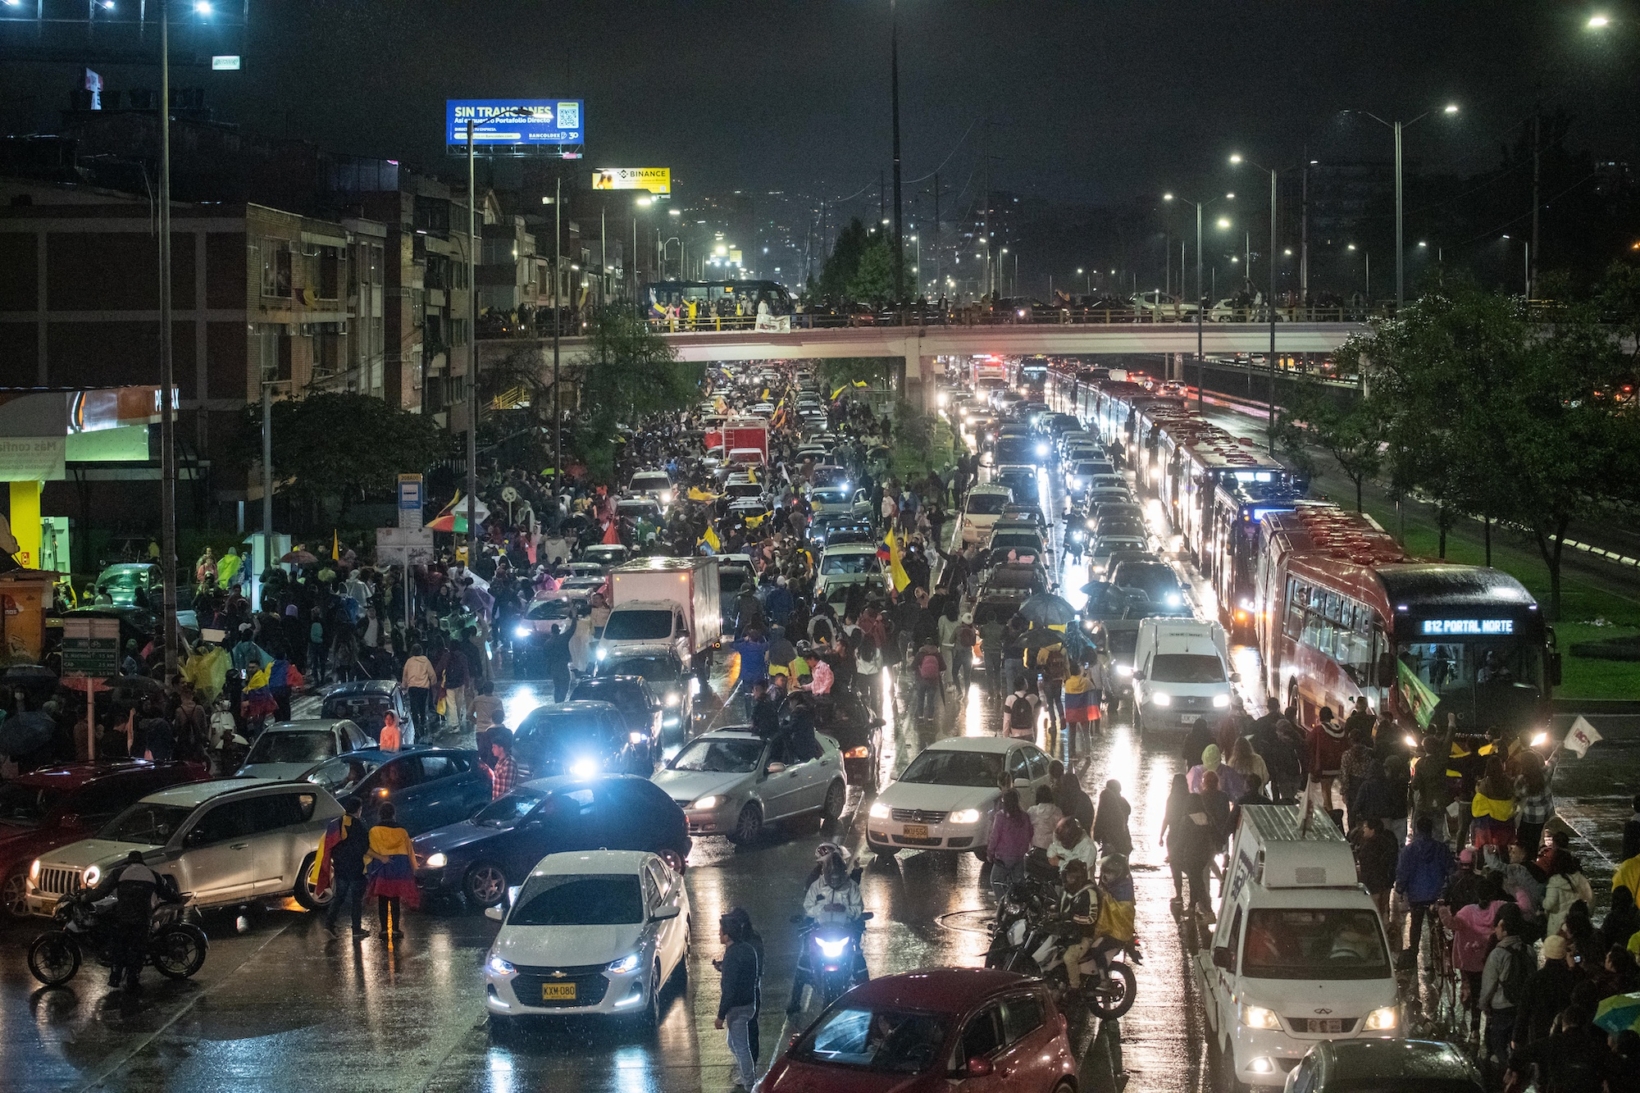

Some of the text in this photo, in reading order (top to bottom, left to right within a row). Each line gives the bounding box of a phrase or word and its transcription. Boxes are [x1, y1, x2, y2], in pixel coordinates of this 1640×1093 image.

[454, 106, 475, 118] SIN
[568, 132, 579, 140] 30
[1424, 620, 1513, 632] B12 PORTAL NORTE
